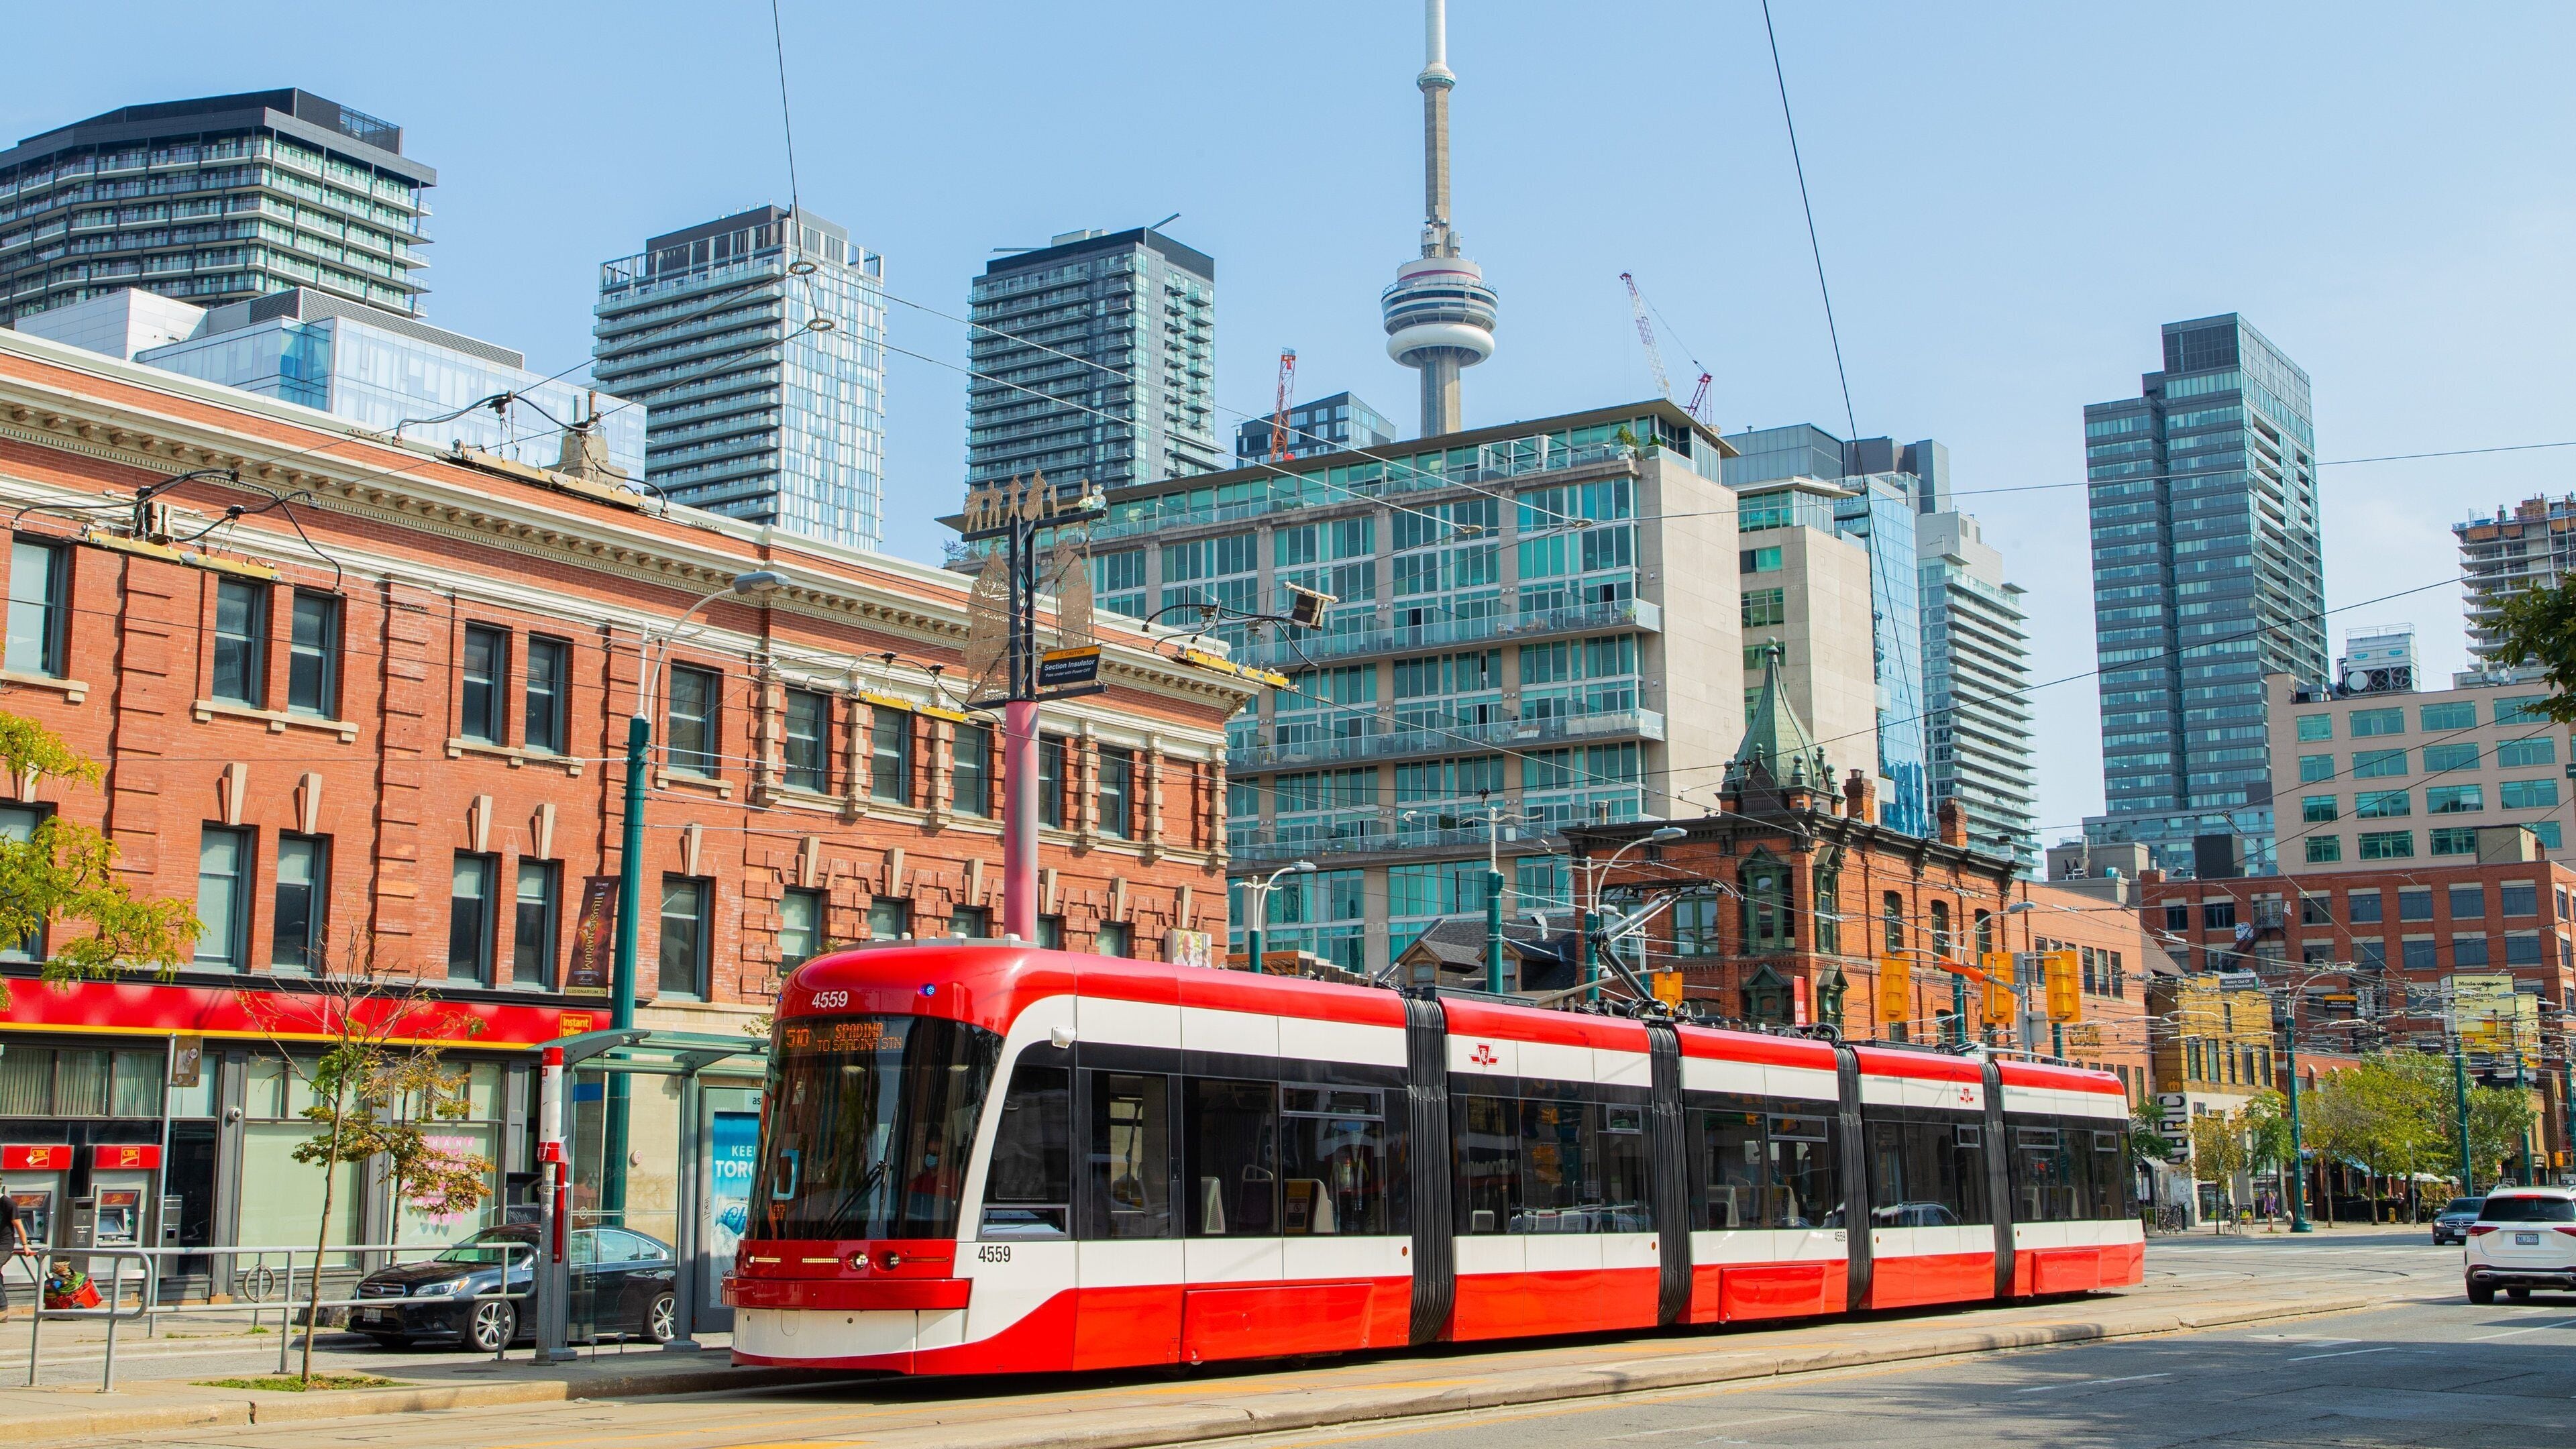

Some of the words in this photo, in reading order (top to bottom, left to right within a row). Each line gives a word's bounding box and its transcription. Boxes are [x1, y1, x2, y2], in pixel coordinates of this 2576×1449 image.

[1044, 663, 1067, 671] Section
[1068, 659, 1095, 667] Insulator
[581, 896, 604, 971] ILLUSIONARIUM
[812, 990, 848, 1008] 4559
[1794, 1001, 1805, 1011] LIVE
[563, 1017, 588, 1027] Instant
[1795, 1013, 1806, 1023] LOVE
[562, 1027, 582, 1036] teller
[836, 1022, 883, 1038] SPADINA
[786, 1028, 810, 1048] 510
[817, 1039, 830, 1052] TO
[832, 1038, 878, 1051] SPADINA
[881, 1036, 902, 1050] STN
[752, 1097, 762, 1105] as
[2159, 1095, 2188, 1165] ABRIC
[32, 1149, 48, 1157] CIBC
[123, 1149, 138, 1157] CIBC
[731, 1145, 755, 1157] KEE
[1835, 1231, 1845, 1242] 4559
[978, 1245, 1011, 1263] 4559
